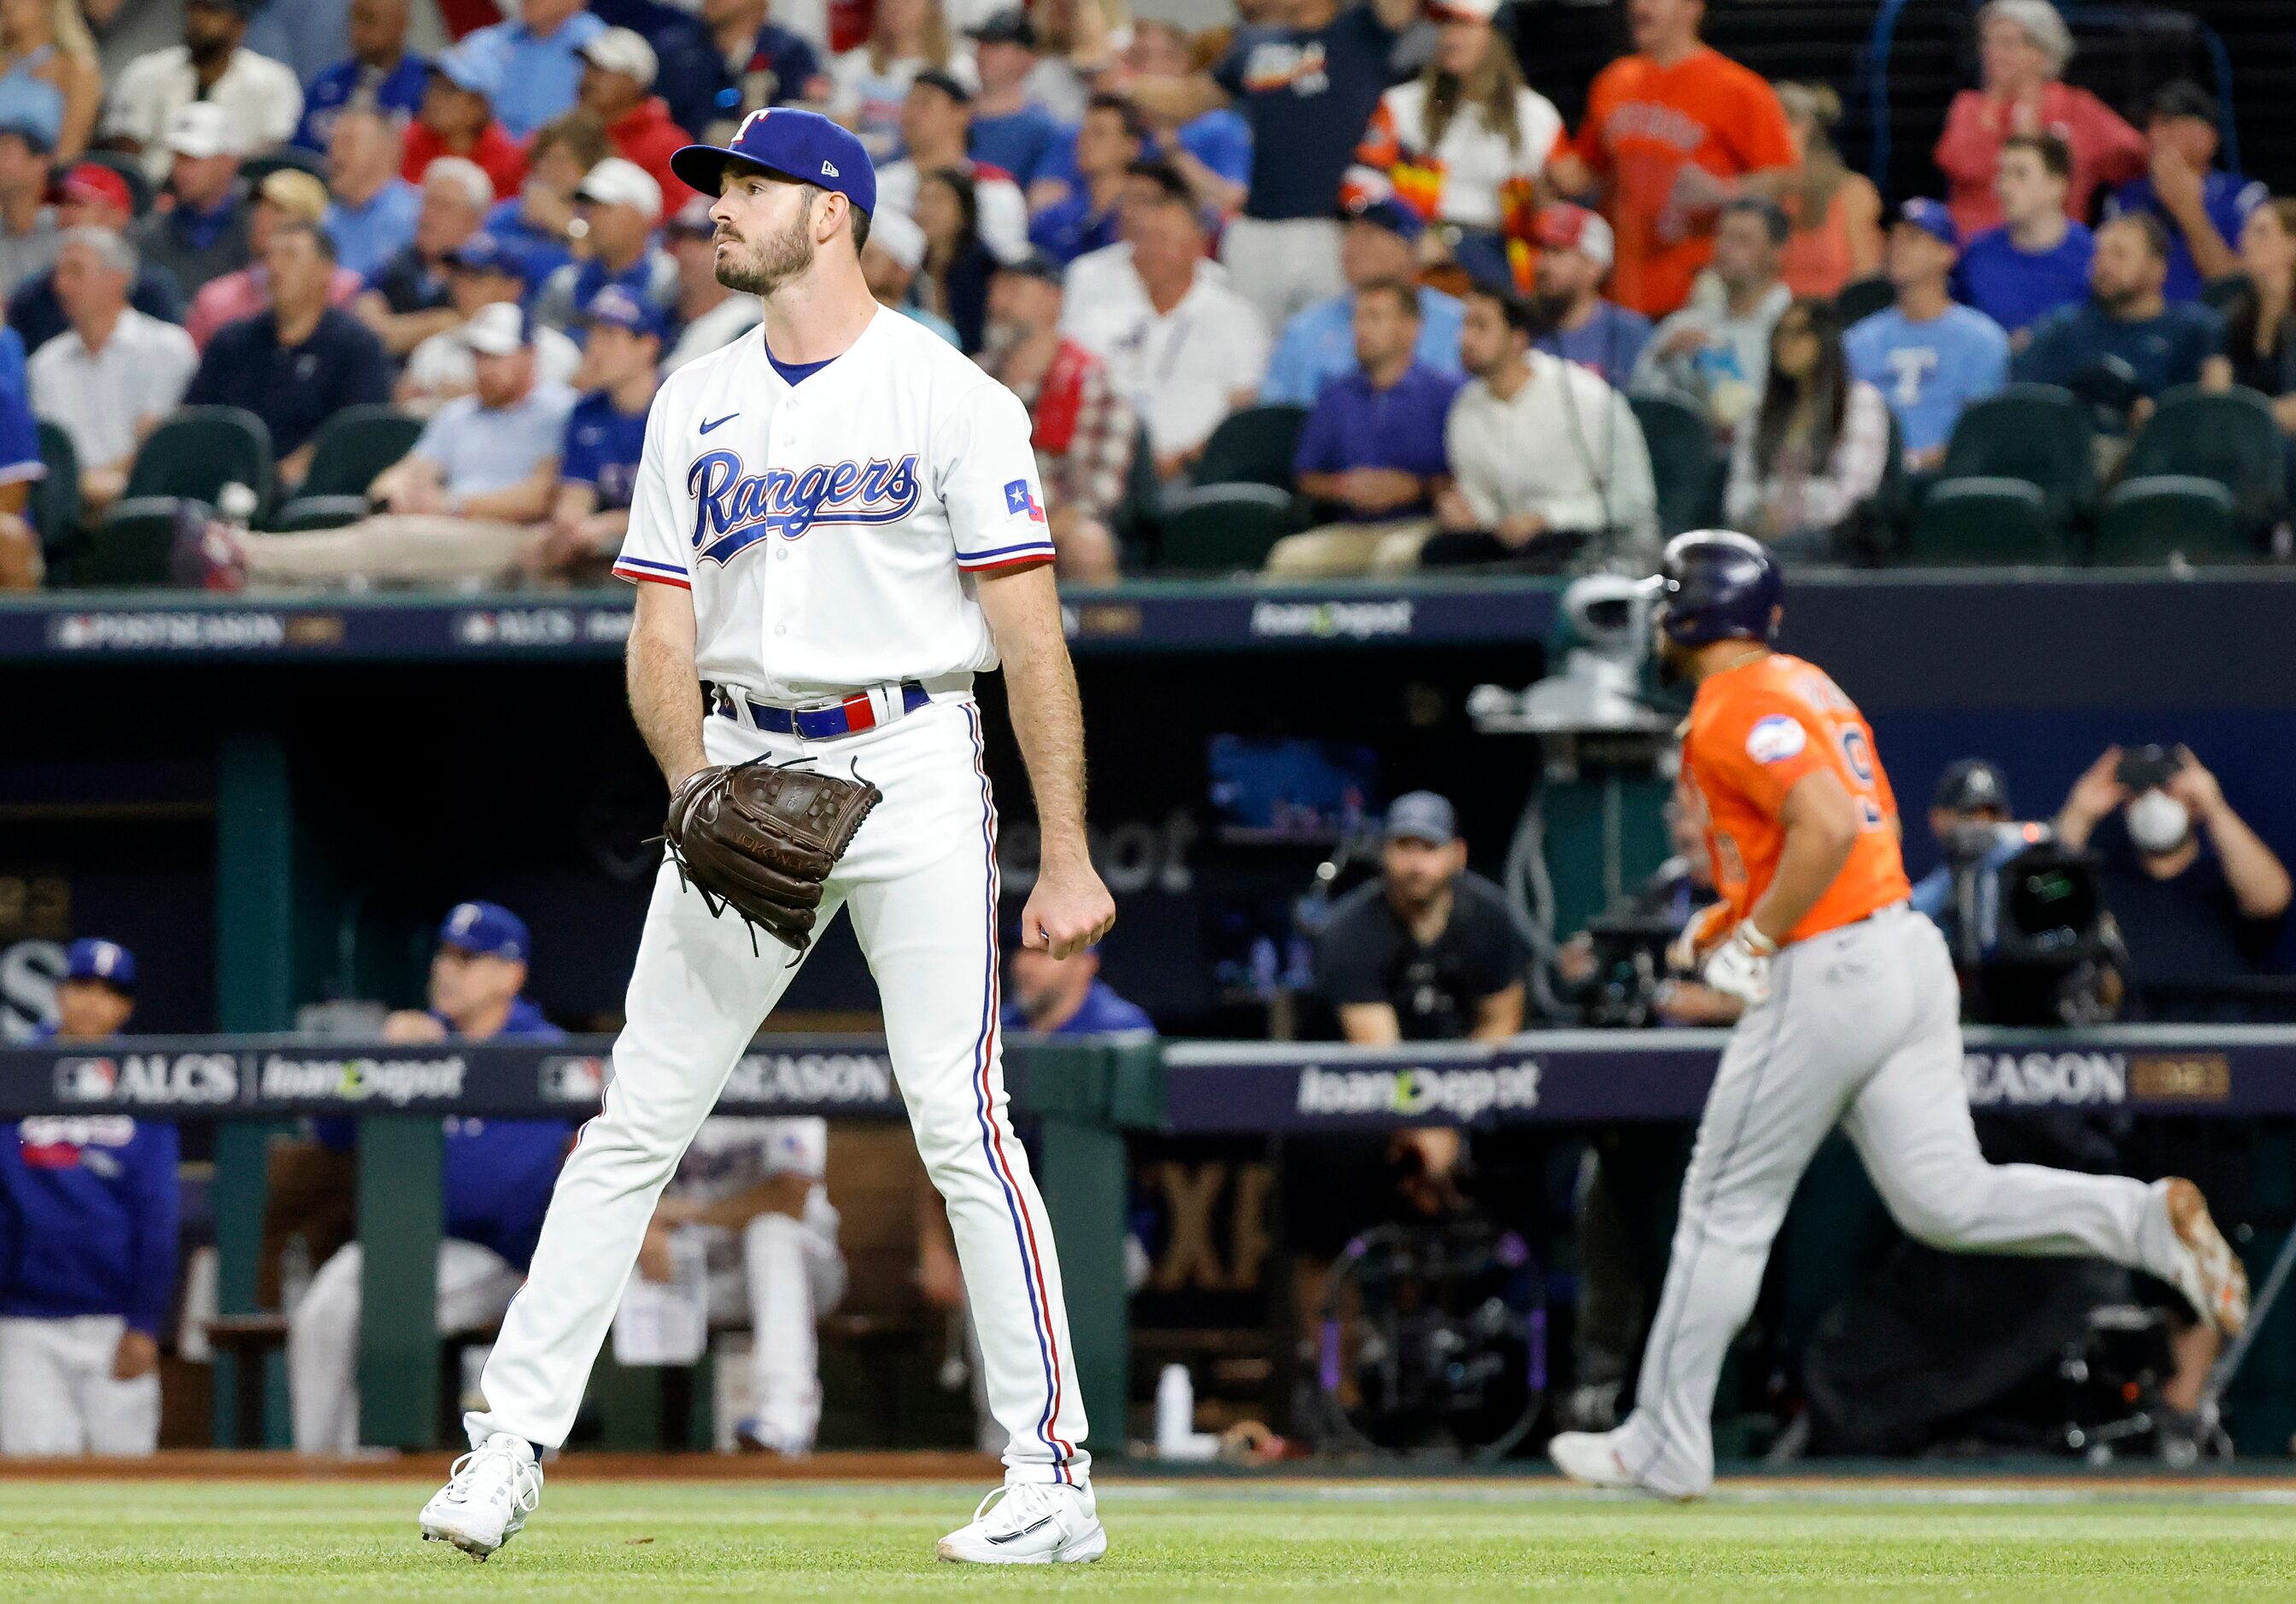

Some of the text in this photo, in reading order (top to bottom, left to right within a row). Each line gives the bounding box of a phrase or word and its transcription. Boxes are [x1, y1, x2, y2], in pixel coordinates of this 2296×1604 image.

[731, 108, 771, 144] T
[1885, 345, 1938, 407] T
[687, 448, 922, 562] Rangers
[1250, 600, 1415, 639] loanDepot
[120, 1053, 237, 1103] ALCS
[261, 1054, 466, 1107] loanDepot
[1297, 1063, 1543, 1122] loanDepot
[1963, 1052, 2125, 1104] EASON
